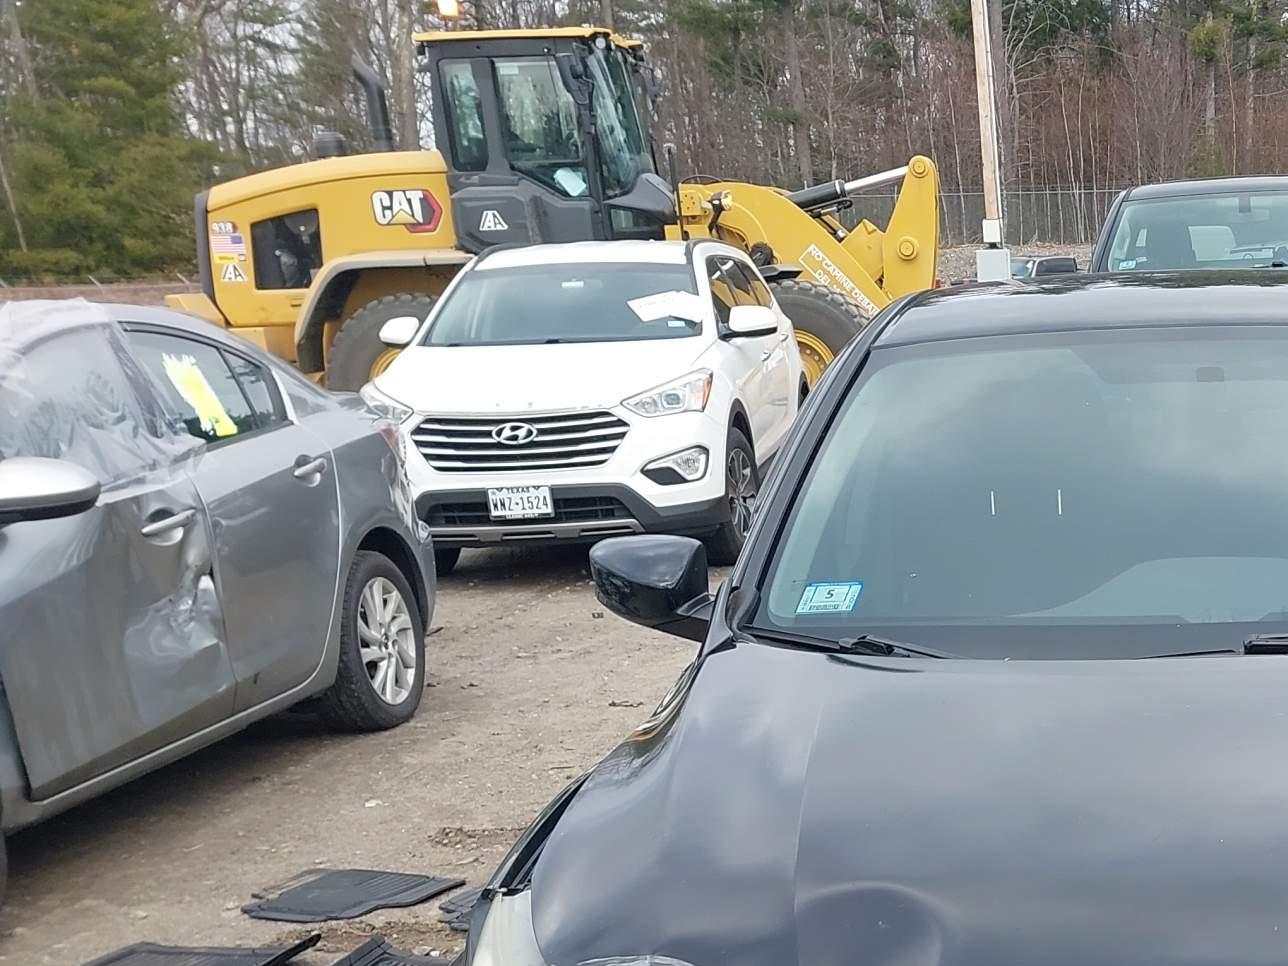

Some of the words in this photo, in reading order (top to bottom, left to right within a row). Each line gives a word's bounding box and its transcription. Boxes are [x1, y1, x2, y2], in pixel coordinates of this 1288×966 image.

[372, 190, 424, 225] CAT
[507, 486, 531, 494] TEXAS
[824, 589, 836, 600] 5
